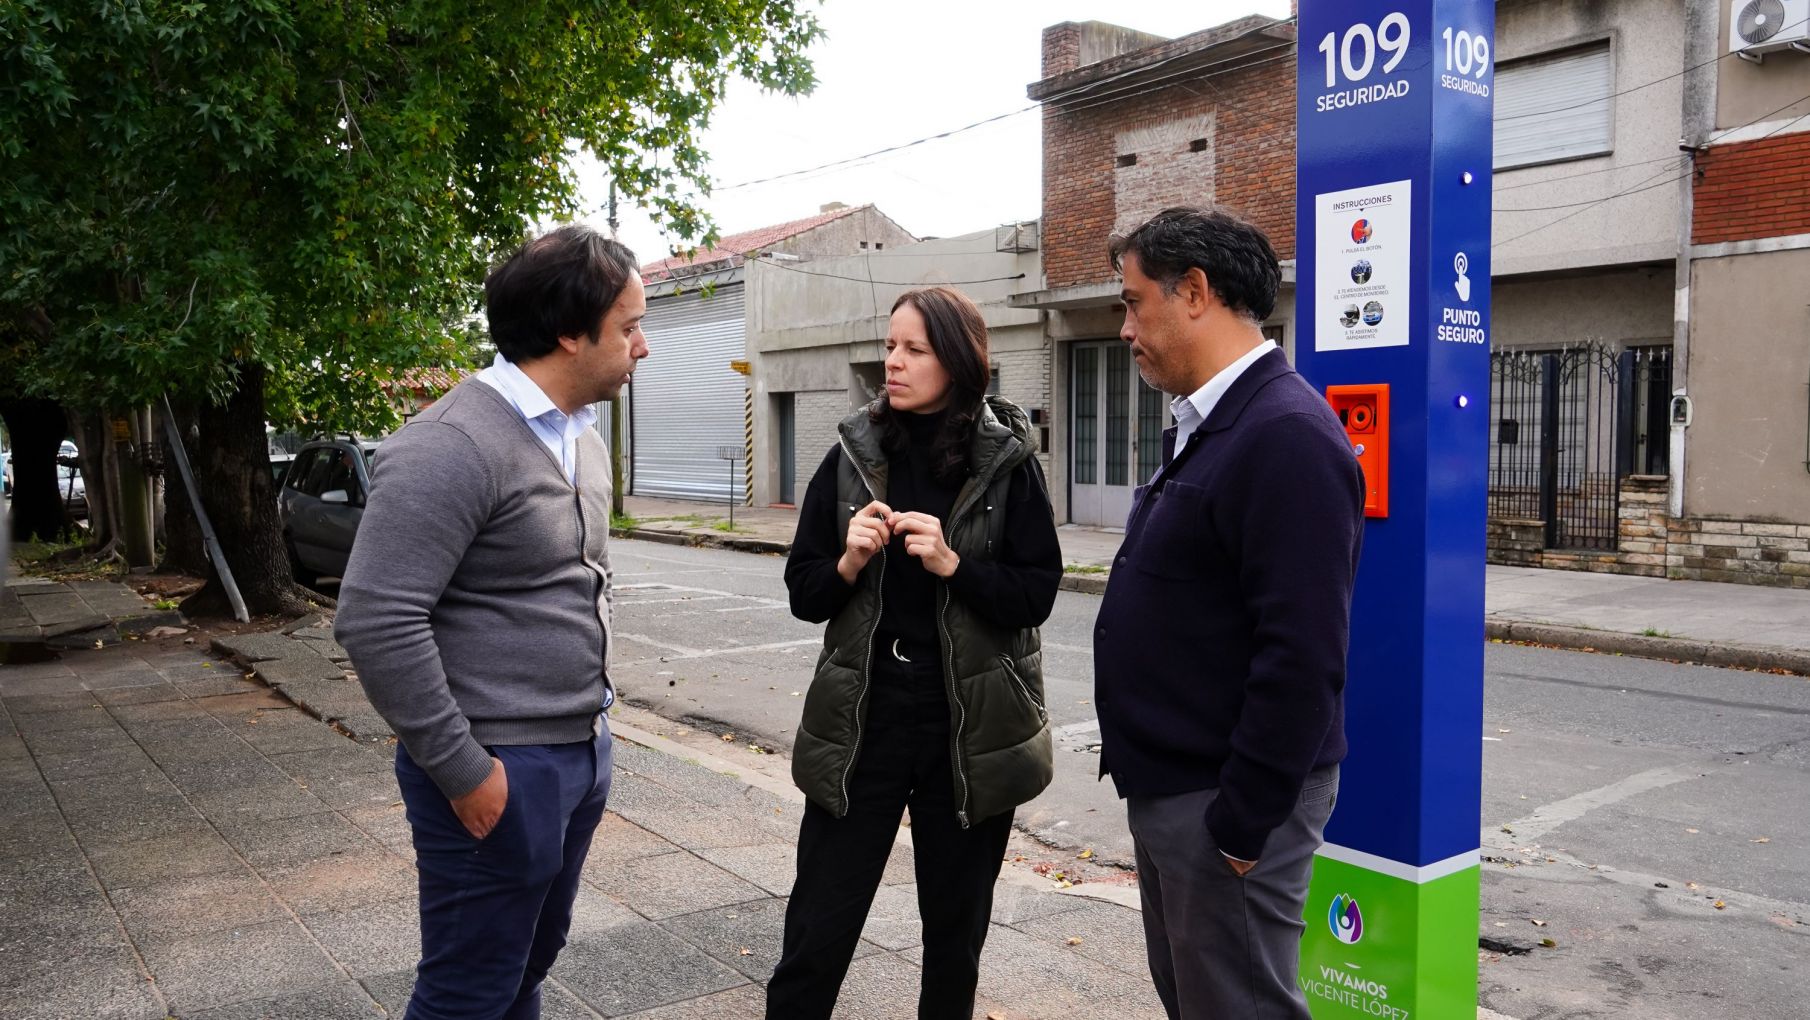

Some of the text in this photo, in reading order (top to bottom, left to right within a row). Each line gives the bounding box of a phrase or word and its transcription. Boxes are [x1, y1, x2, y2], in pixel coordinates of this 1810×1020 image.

[1318, 12, 1411, 88] 109
[1442, 27, 1490, 79] 109
[1316, 79, 1410, 112] SEGURIDAD
[1441, 74, 1489, 98] SEGURIDAD
[1333, 194, 1393, 211] INSTRUCCIONES
[1443, 307, 1480, 326] PUNTO
[1438, 325, 1485, 344] SEGURO
[1301, 976, 1359, 1009] VICENTE
[1320, 965, 1387, 999] VIVAMOS
